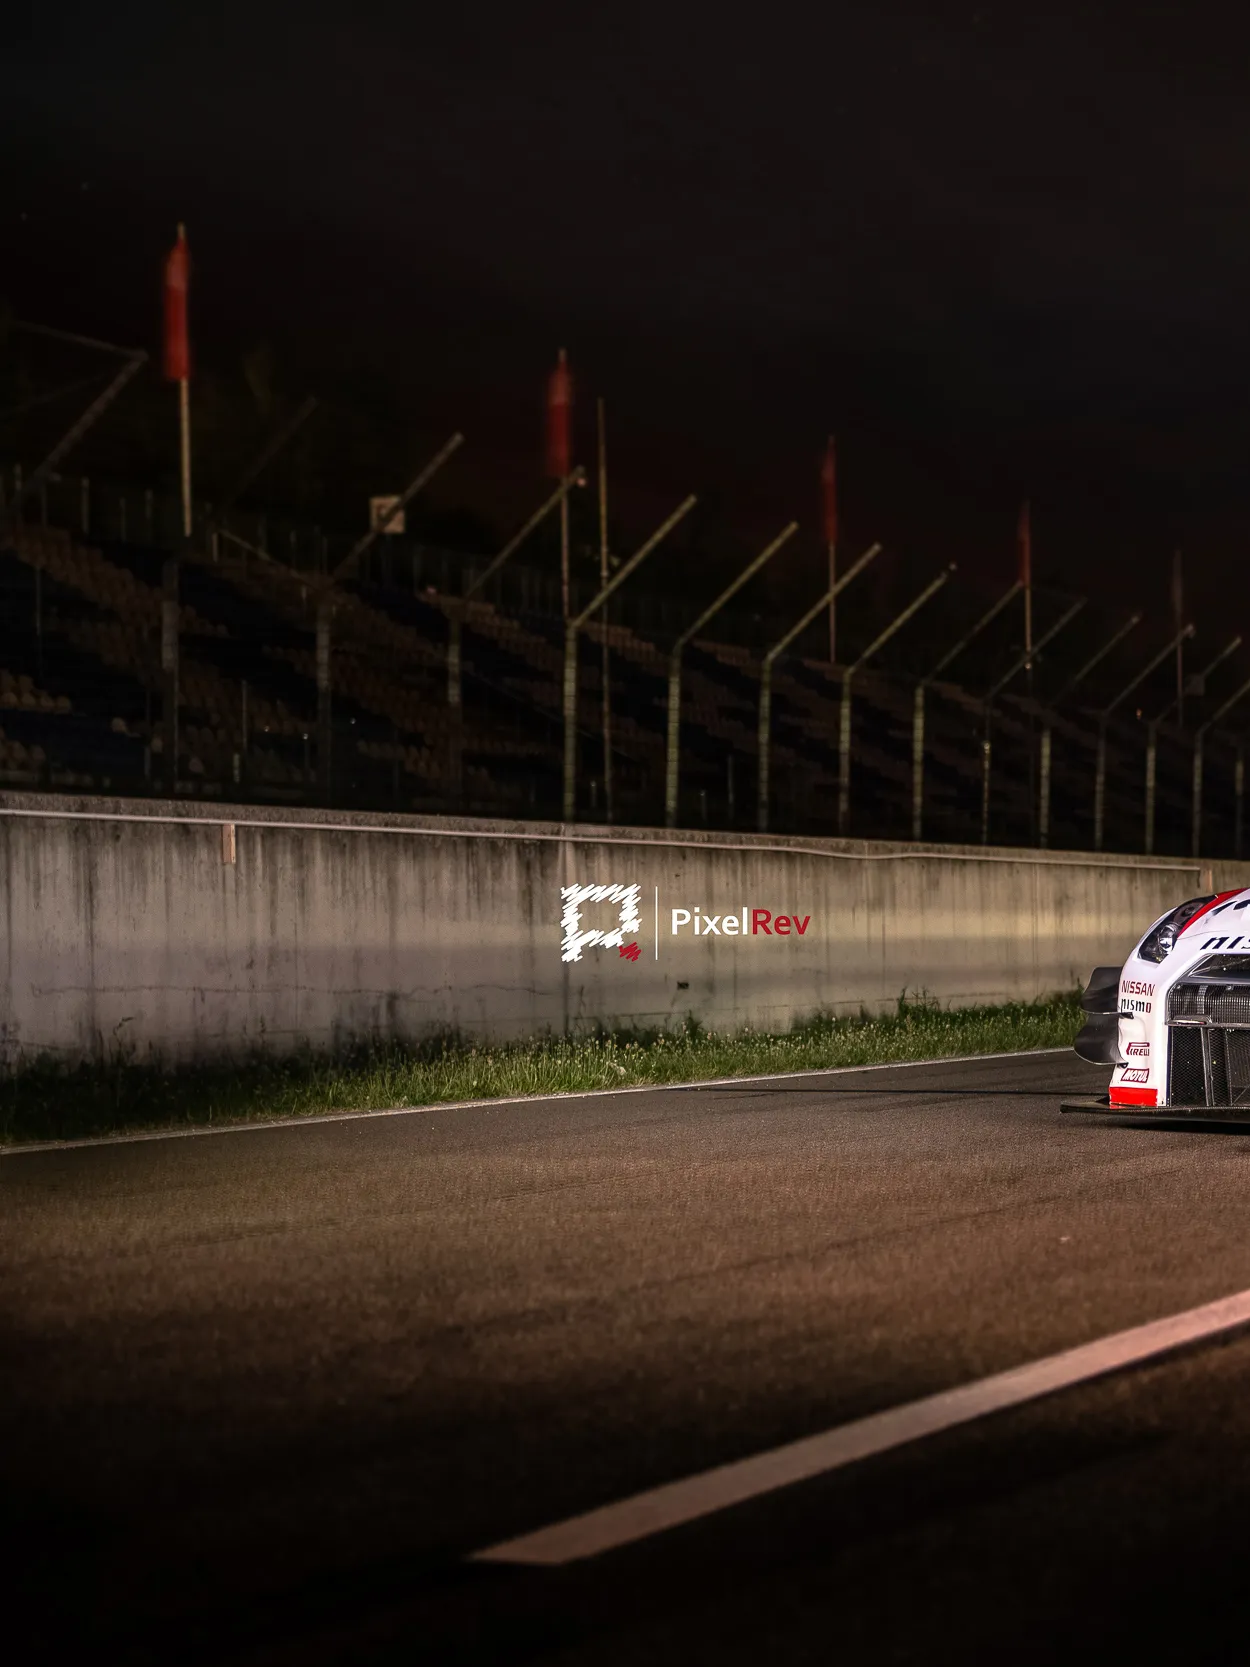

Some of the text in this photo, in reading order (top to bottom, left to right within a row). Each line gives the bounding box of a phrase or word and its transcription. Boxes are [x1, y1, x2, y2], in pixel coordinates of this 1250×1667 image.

[1121, 980, 1156, 997] NISSAN
[1121, 998, 1152, 1014] nismo
[1123, 1068, 1148, 1082] MOTUL
